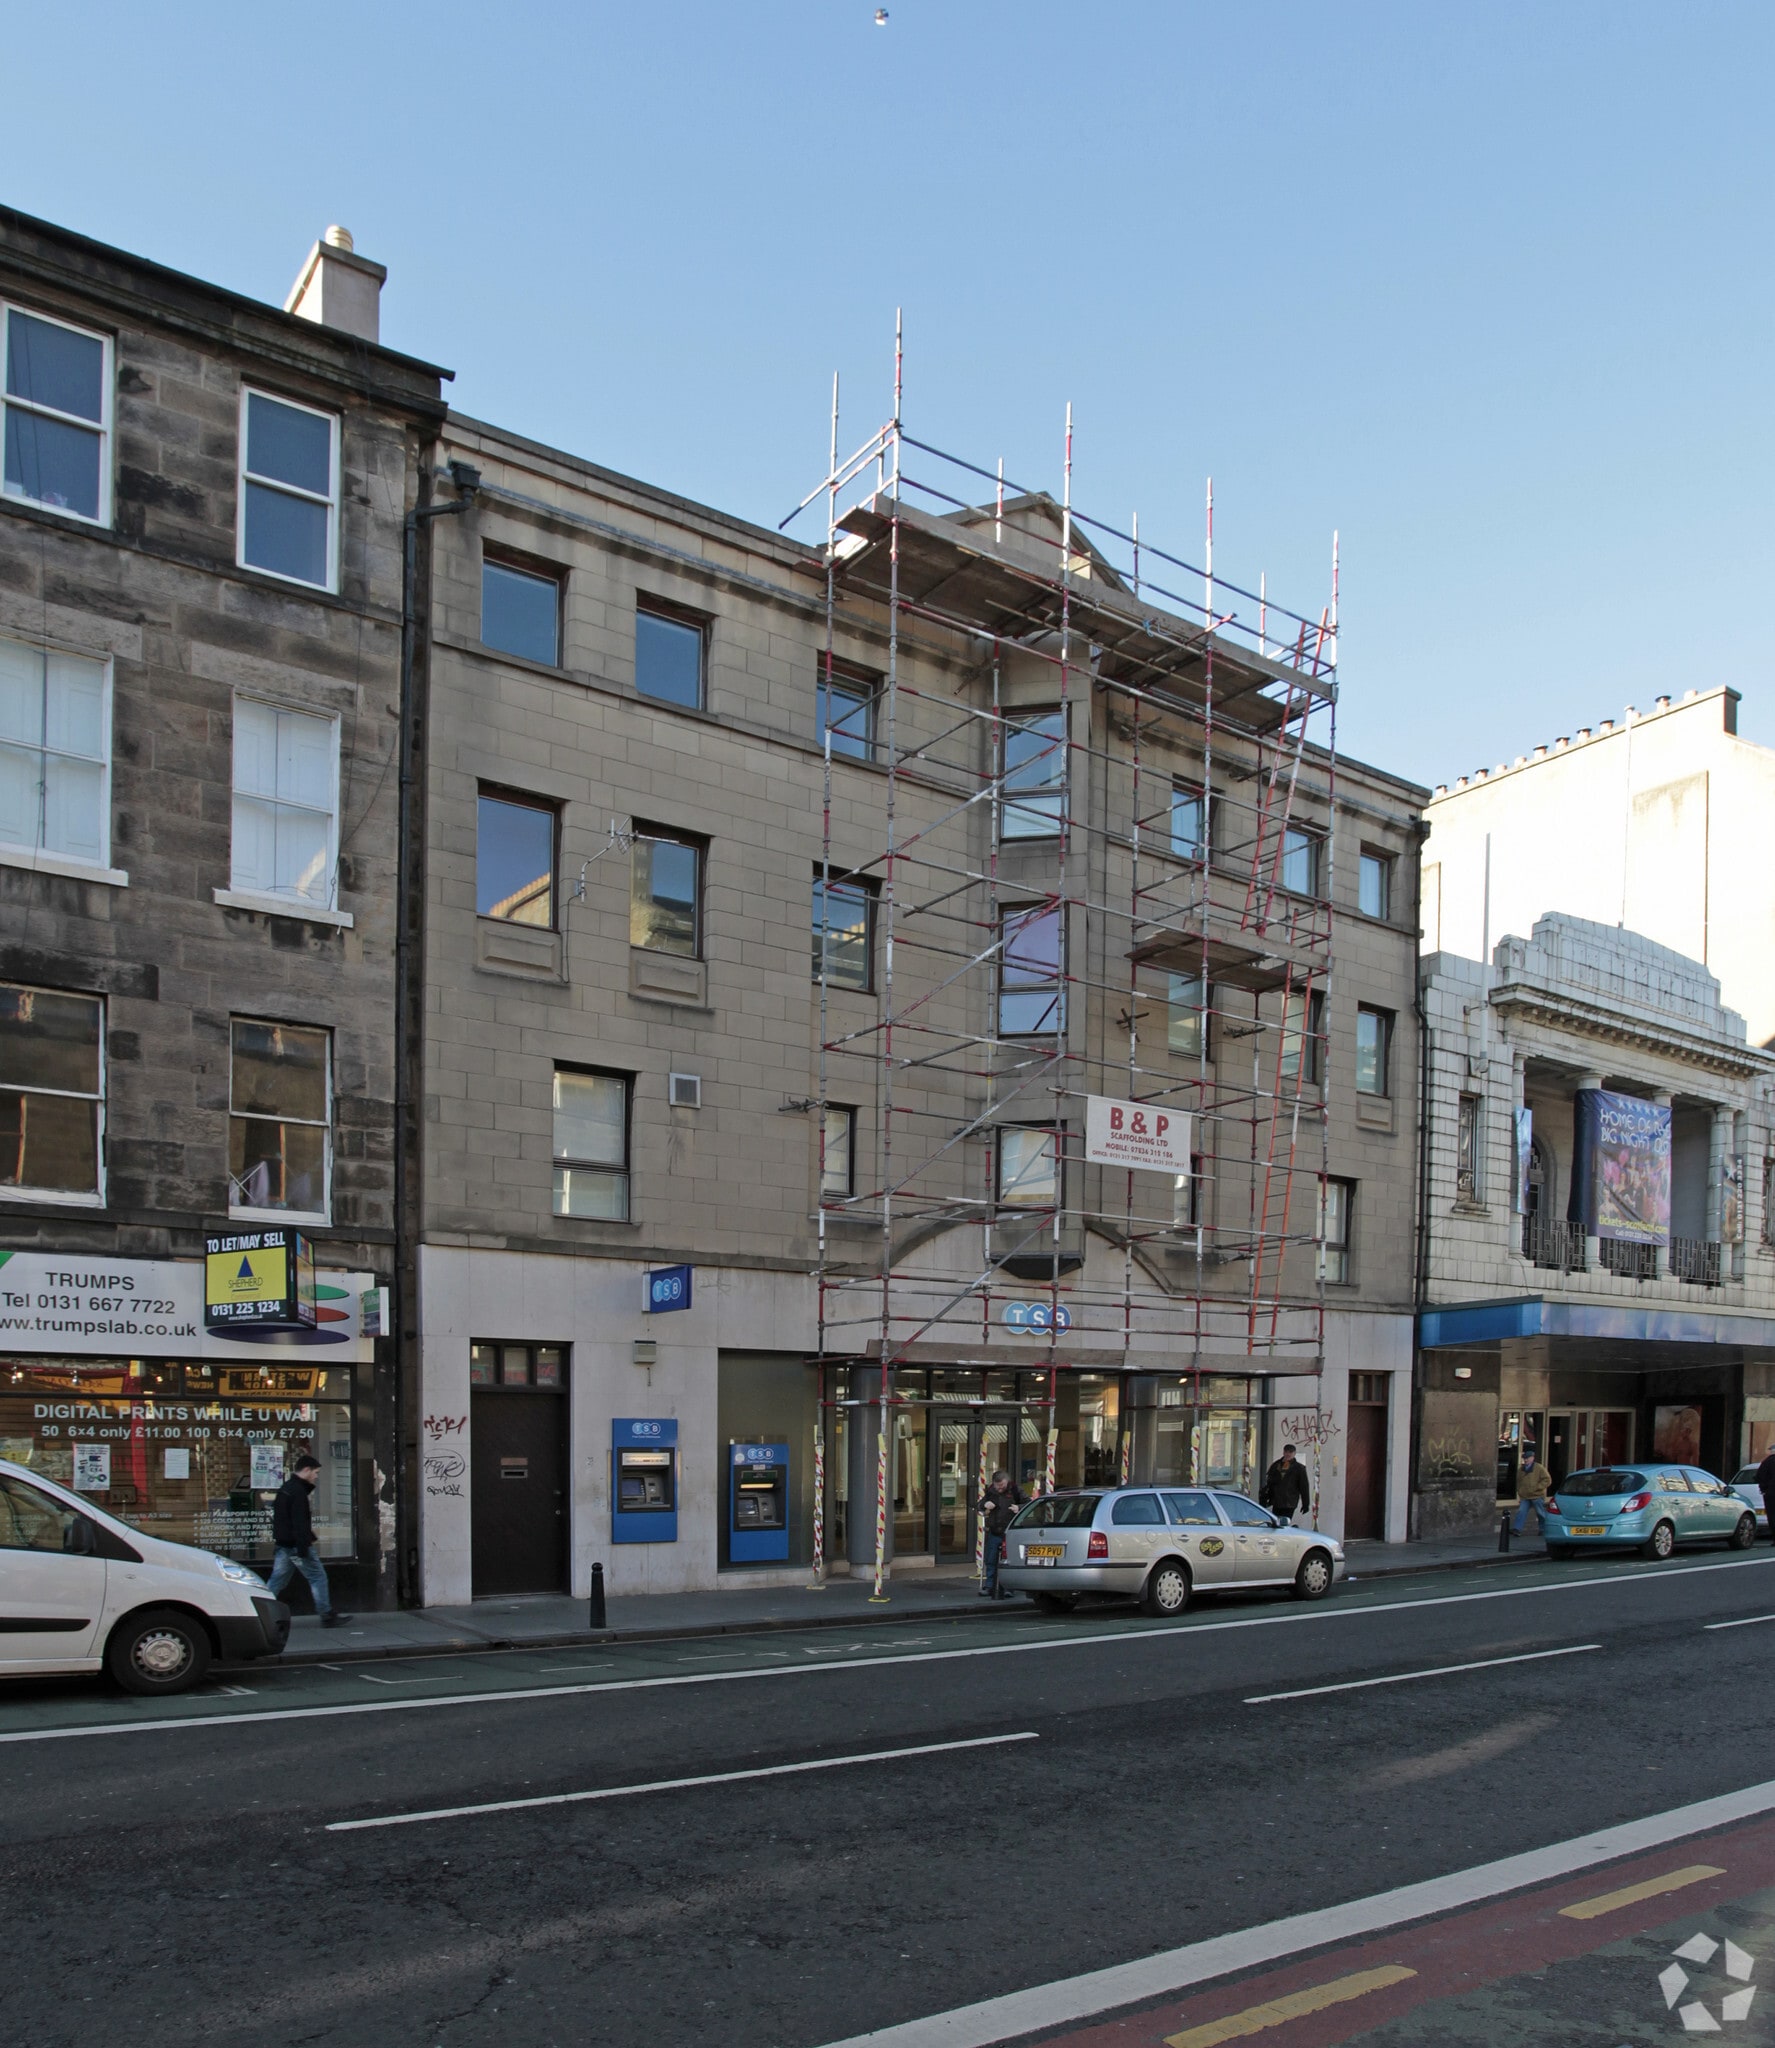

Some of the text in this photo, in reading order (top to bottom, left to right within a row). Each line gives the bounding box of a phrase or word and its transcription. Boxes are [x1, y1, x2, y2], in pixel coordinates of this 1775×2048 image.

[1110, 1106, 1169, 1137] B & P
[1600, 1108, 1635, 1130] HOME
[1638, 1117, 1651, 1134] OF
[1105, 1142, 1129, 1153] MOBILE:
[1110, 1131, 1169, 1147] SCAFFOLDING LTD
[1601, 1126, 1618, 1144] BIG
[1621, 1131, 1650, 1150] NIGHT
[207, 1231, 286, 1253] TO LET/MAY SELL
[45, 1271, 135, 1291] TRUMPS
[228, 1276, 264, 1289] SHEPHERD
[2, 1292, 176, 1315] Tel 0131 667 7722
[212, 1300, 281, 1316] 0131 225 1234
[34, 1403, 319, 1422] DIGITAL PRINTS WHILE U WAIT
[41, 1425, 59, 1437] 50
[100, 1426, 131, 1440] only
[135, 1427, 181, 1439] £11.00
[186, 1427, 211, 1438] 100
[247, 1428, 276, 1440] only
[279, 1428, 314, 1439] £7.50
[1047, 1547, 1062, 1556] PVU
